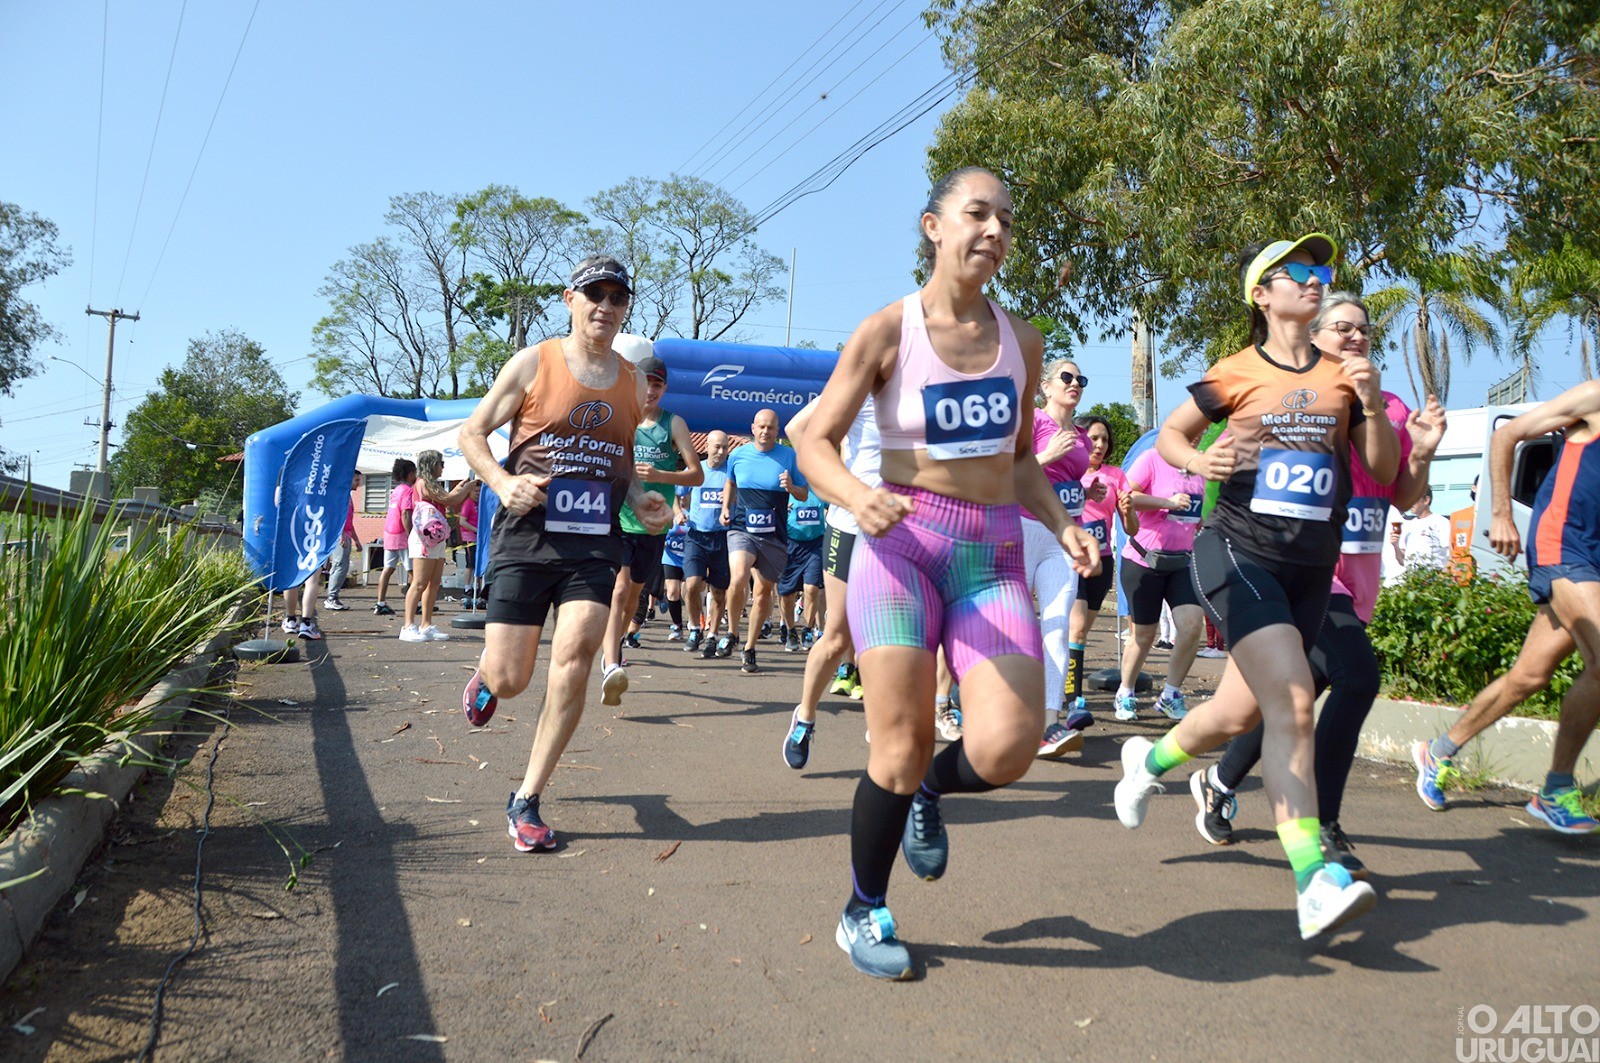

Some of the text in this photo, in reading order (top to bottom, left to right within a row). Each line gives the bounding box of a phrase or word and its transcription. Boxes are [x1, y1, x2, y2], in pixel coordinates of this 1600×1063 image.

[711, 385, 803, 405] Fecomércio
[935, 392, 1012, 431] 068
[1261, 412, 1337, 425] Med Forma
[1271, 426, 1327, 435] Academia
[539, 432, 625, 457] Med Forma
[305, 434, 325, 495] Fecomércio
[545, 450, 612, 467] Academia
[1265, 461, 1334, 496] 020
[555, 490, 607, 514] 044
[748, 513, 772, 525] 021
[798, 510, 818, 519] 079
[1344, 507, 1384, 532] 053
